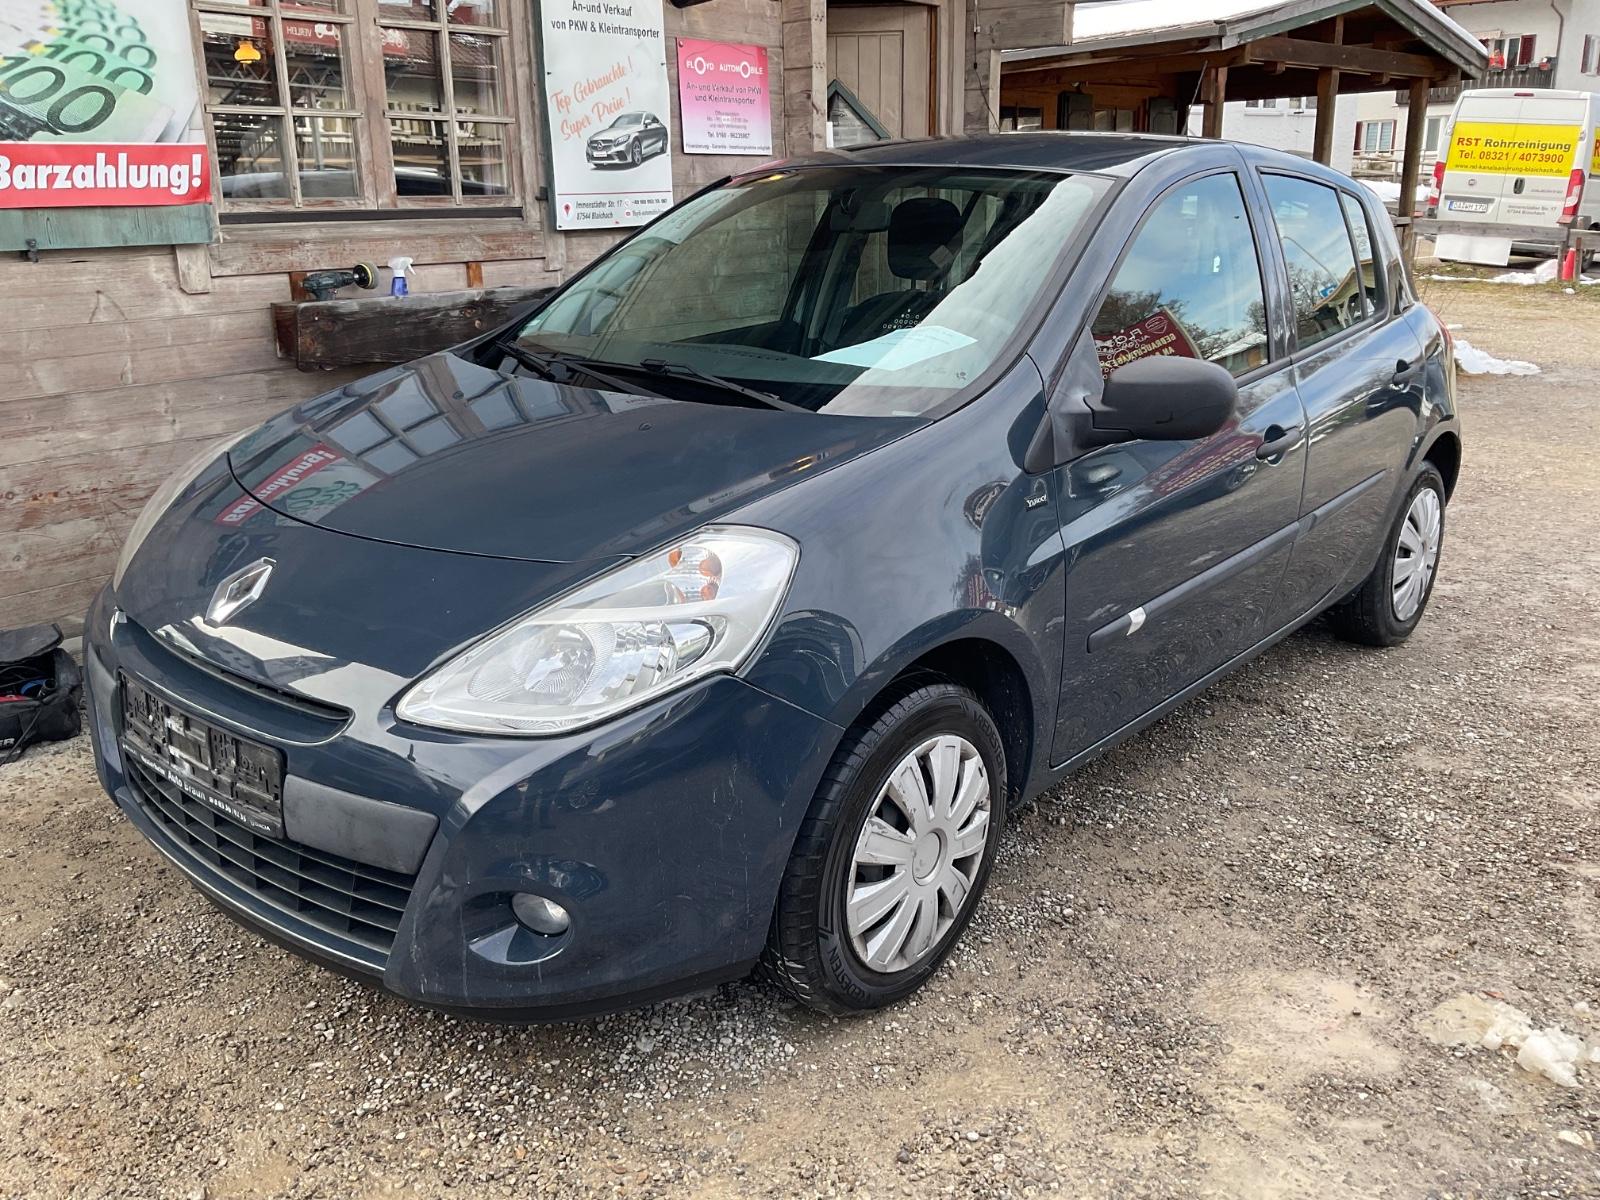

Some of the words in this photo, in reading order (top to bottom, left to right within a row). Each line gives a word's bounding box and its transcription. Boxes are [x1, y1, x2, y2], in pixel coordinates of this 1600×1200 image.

[603, 3, 632, 16] Verkauf
[551, 20, 566, 30] von
[568, 20, 588, 31] PKW
[591, 23, 597, 32] &
[598, 22, 660, 38] Kleintransporter
[686, 57, 714, 75] FLOYD
[719, 61, 764, 79] AUTOMOBILE
[699, 83, 711, 92] und
[712, 83, 735, 93] Verkauf
[747, 87, 762, 95] PKW
[550, 89, 571, 114] Top
[695, 94, 707, 102] und
[708, 94, 756, 105] Kleintransporter
[560, 114, 592, 141] Super
[1456, 137, 1481, 147] RST
[1484, 138, 1571, 152] Rohrreinigung
[1459, 150, 1476, 160] Tel.
[1478, 151, 1510, 161] 08321
[1511, 152, 1516, 161] /
[1518, 153, 1564, 164] 4073900
[0, 152, 203, 196] Barzahlung!
[576, 212, 591, 221] 87544
